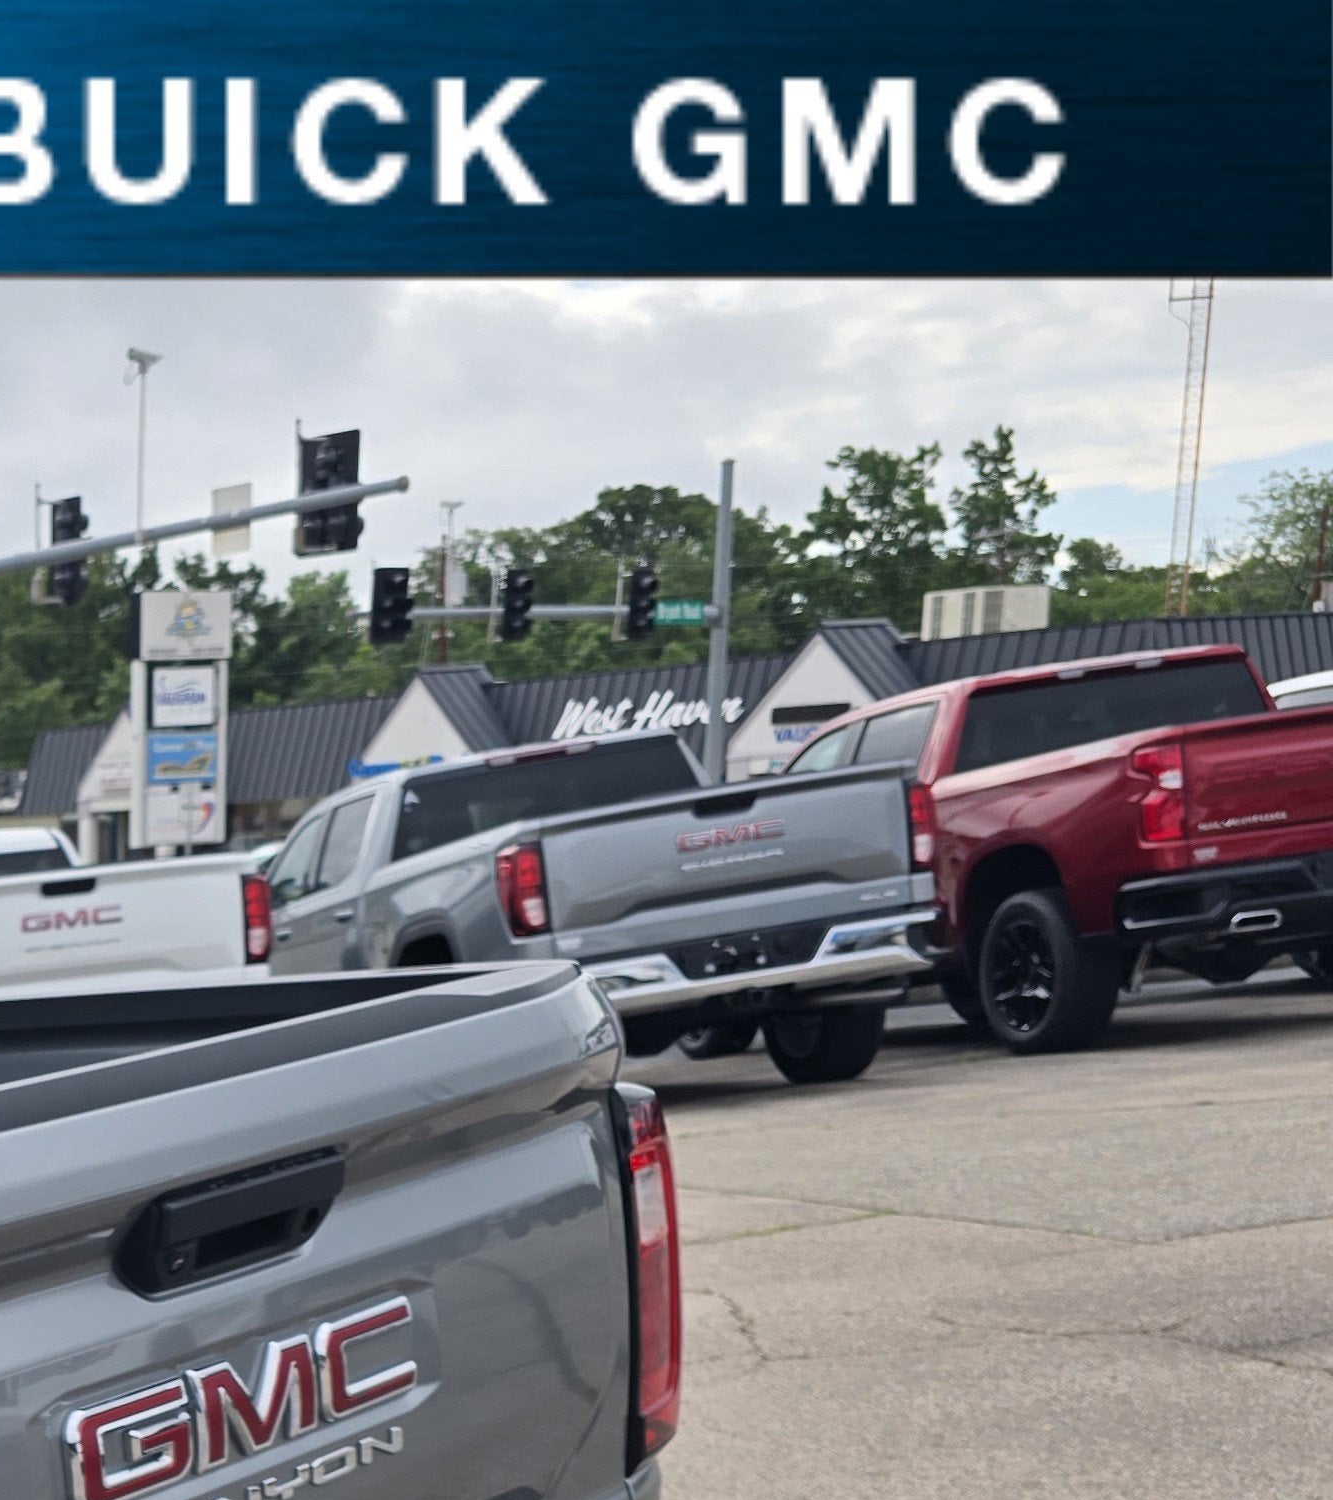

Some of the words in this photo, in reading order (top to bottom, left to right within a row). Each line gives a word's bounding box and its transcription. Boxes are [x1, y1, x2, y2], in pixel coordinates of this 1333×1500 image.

[551, 696, 633, 740] West
[632, 689, 745, 732] Havn
[675, 818, 786, 854] GMC
[19, 903, 123, 933] GMC
